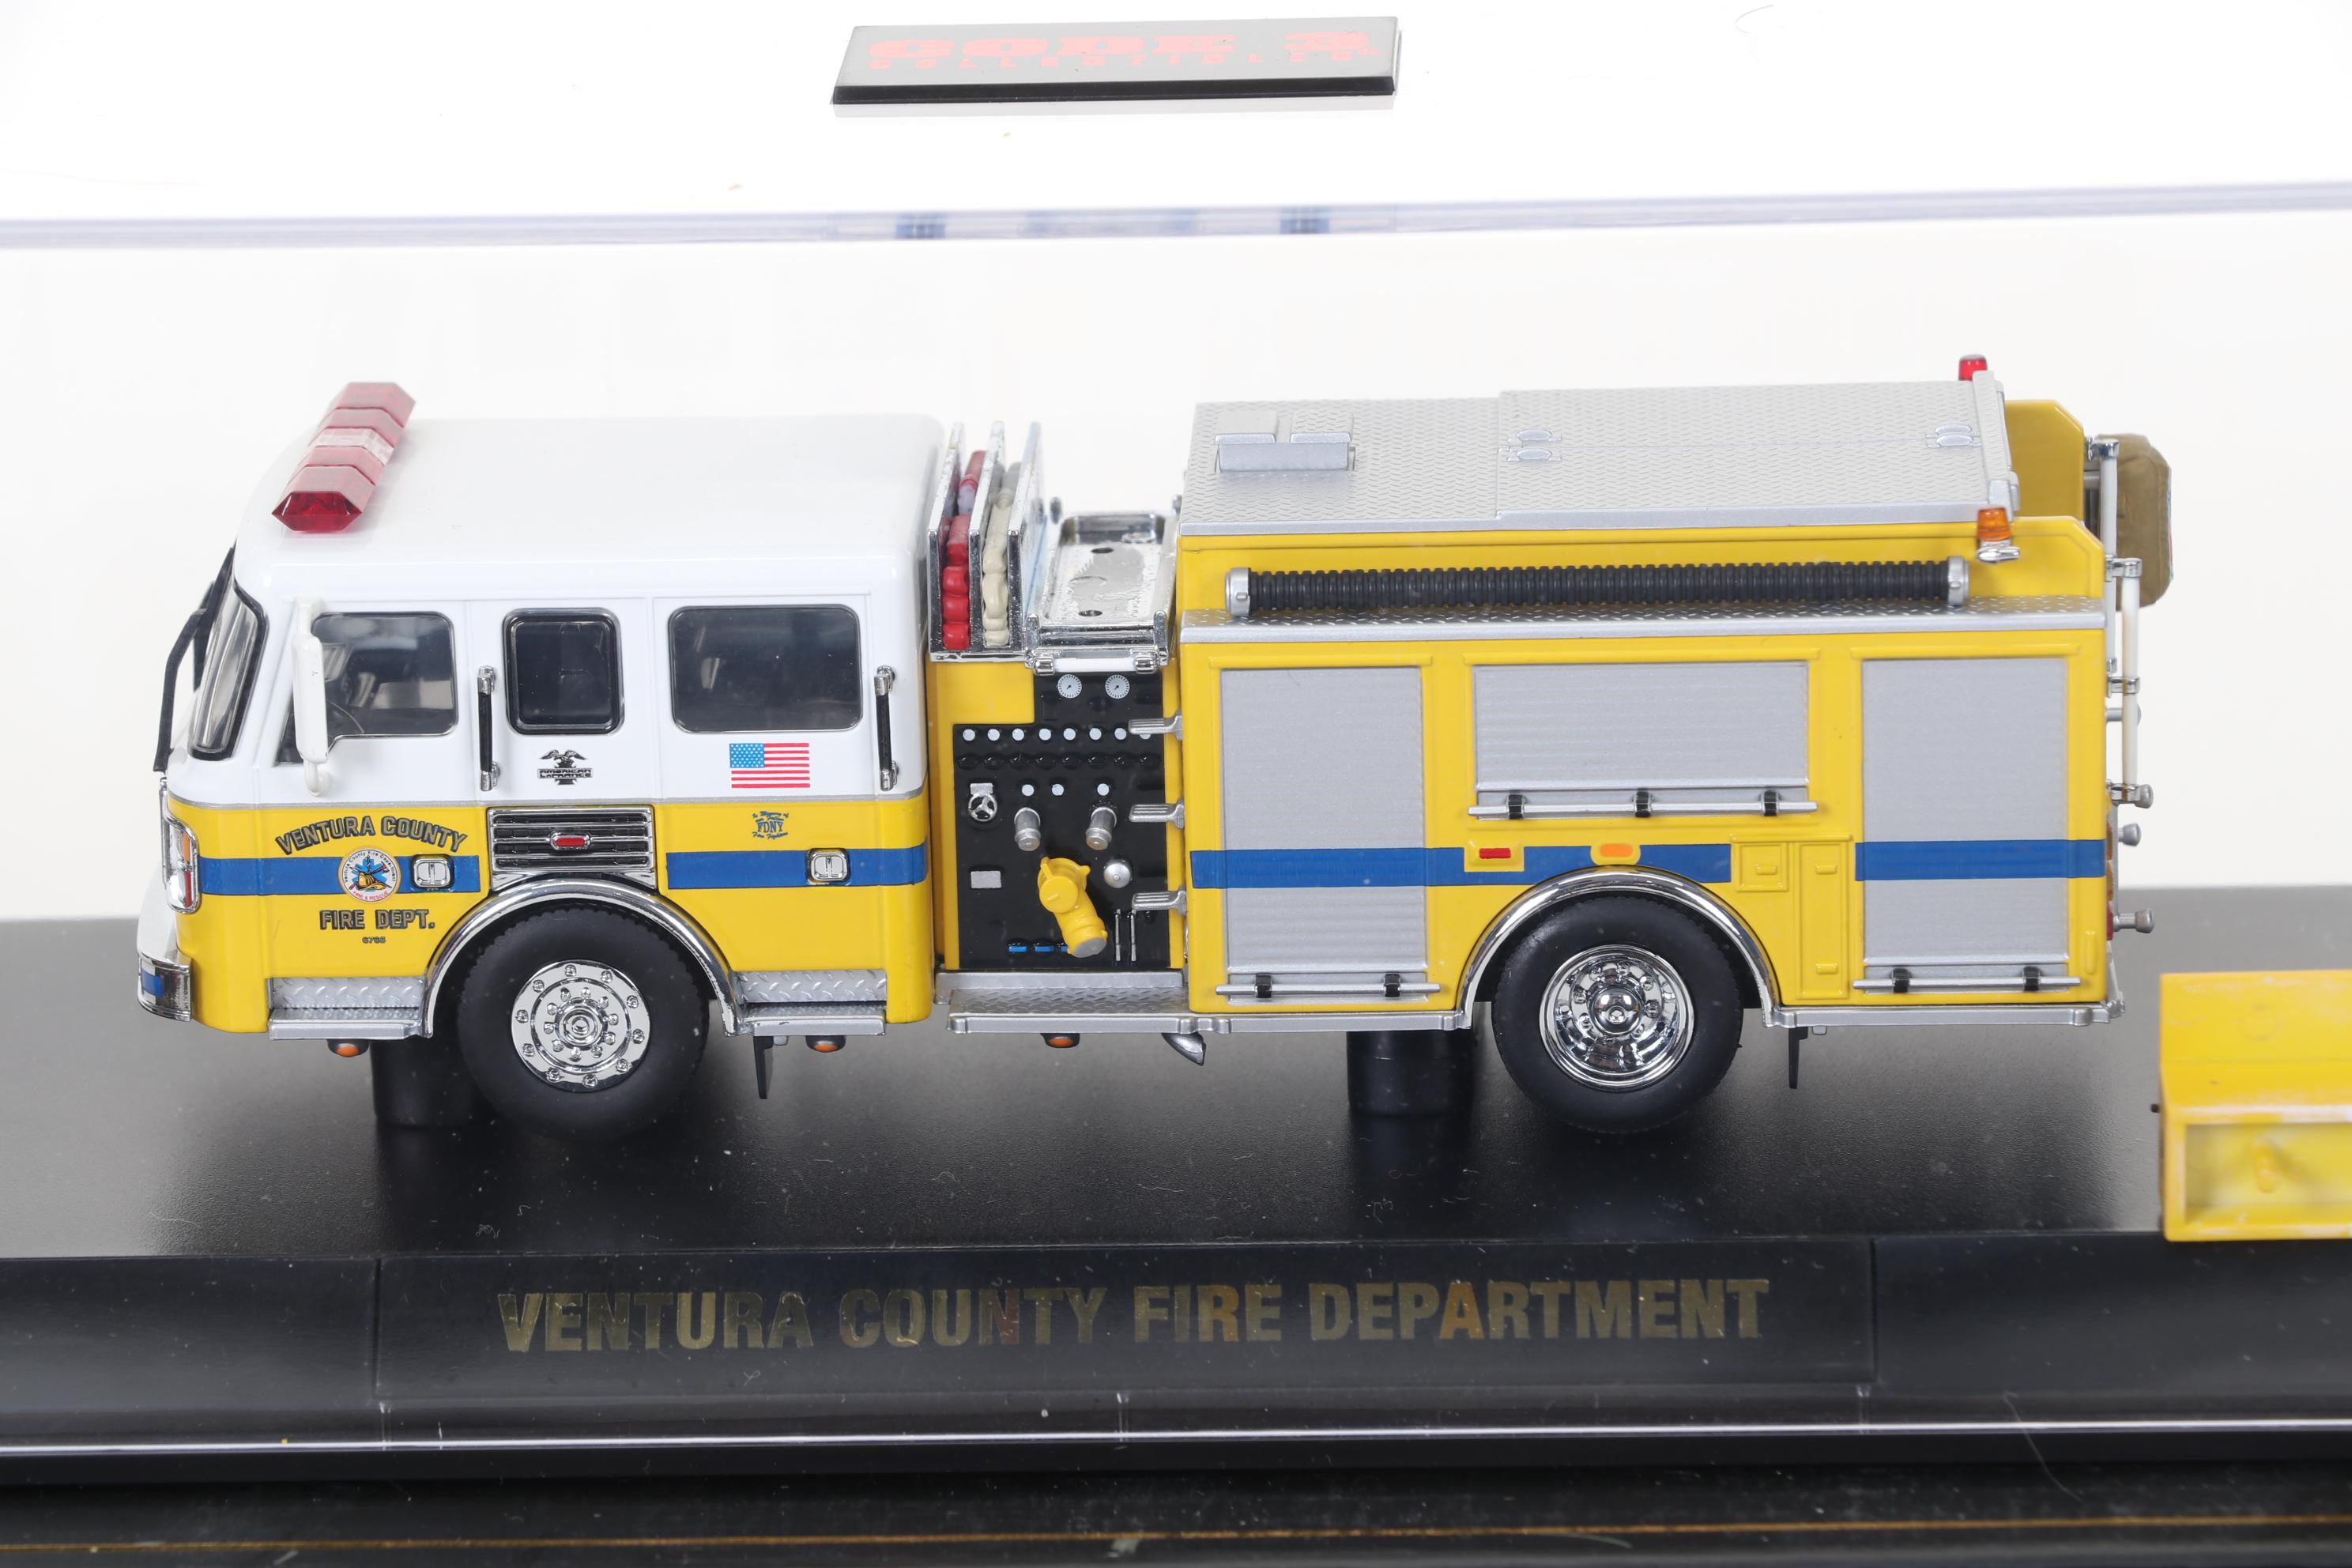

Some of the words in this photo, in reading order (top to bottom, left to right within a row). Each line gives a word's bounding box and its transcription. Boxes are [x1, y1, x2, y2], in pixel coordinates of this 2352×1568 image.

[869, 36, 1235, 58] CODE
[1283, 32, 1369, 51] 3
[275, 816, 375, 855] VENTURA
[381, 816, 468, 852] COUNTY
[757, 820, 783, 833] FDNY
[319, 910, 365, 930] FIRE
[375, 909, 435, 929] DEPT.
[498, 1290, 814, 1353] VENTURA
[839, 1286, 1107, 1349] COUNTY
[1133, 1283, 1283, 1343] FIRE
[1308, 1278, 1770, 1341] DEPARTMENT
